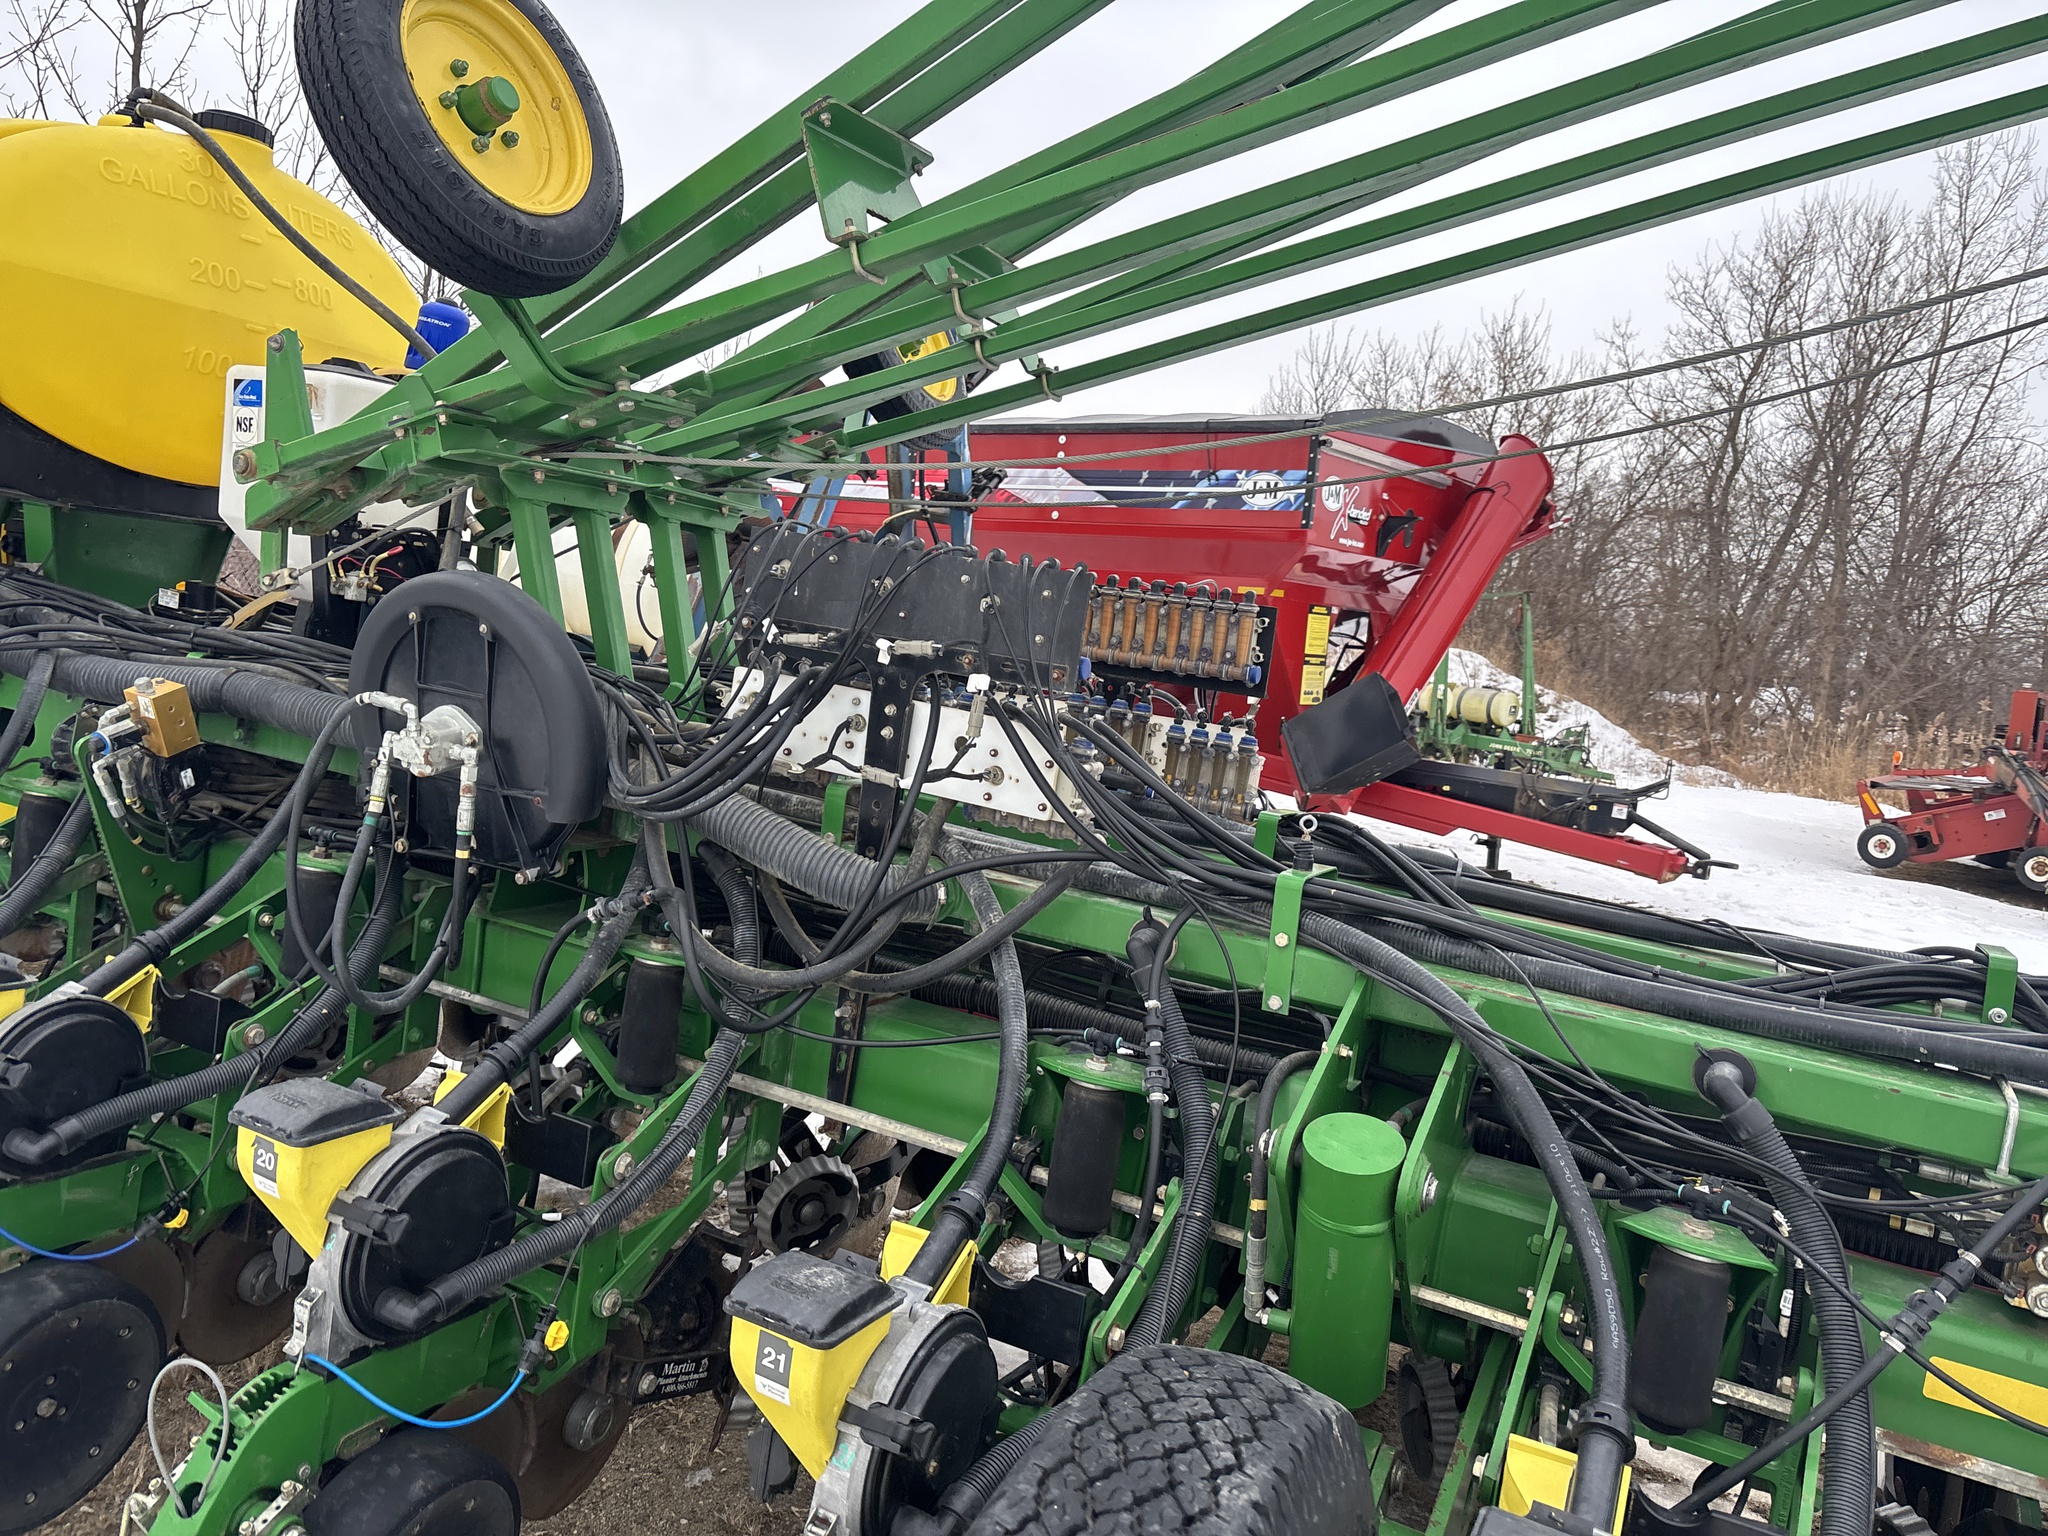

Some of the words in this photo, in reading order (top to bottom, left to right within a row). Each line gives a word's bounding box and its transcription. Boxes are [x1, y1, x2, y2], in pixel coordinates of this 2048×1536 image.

[99, 156, 250, 219] GALLONS
[411, 130, 542, 246] CARLISLE
[272, 198, 356, 250] ITERS
[189, 257, 241, 292] 200
[295, 277, 334, 310] 800
[236, 416, 254, 433] NSF
[256, 1148, 275, 1171] 20
[661, 1360, 696, 1377] Martin
[761, 1346, 786, 1374] 21
